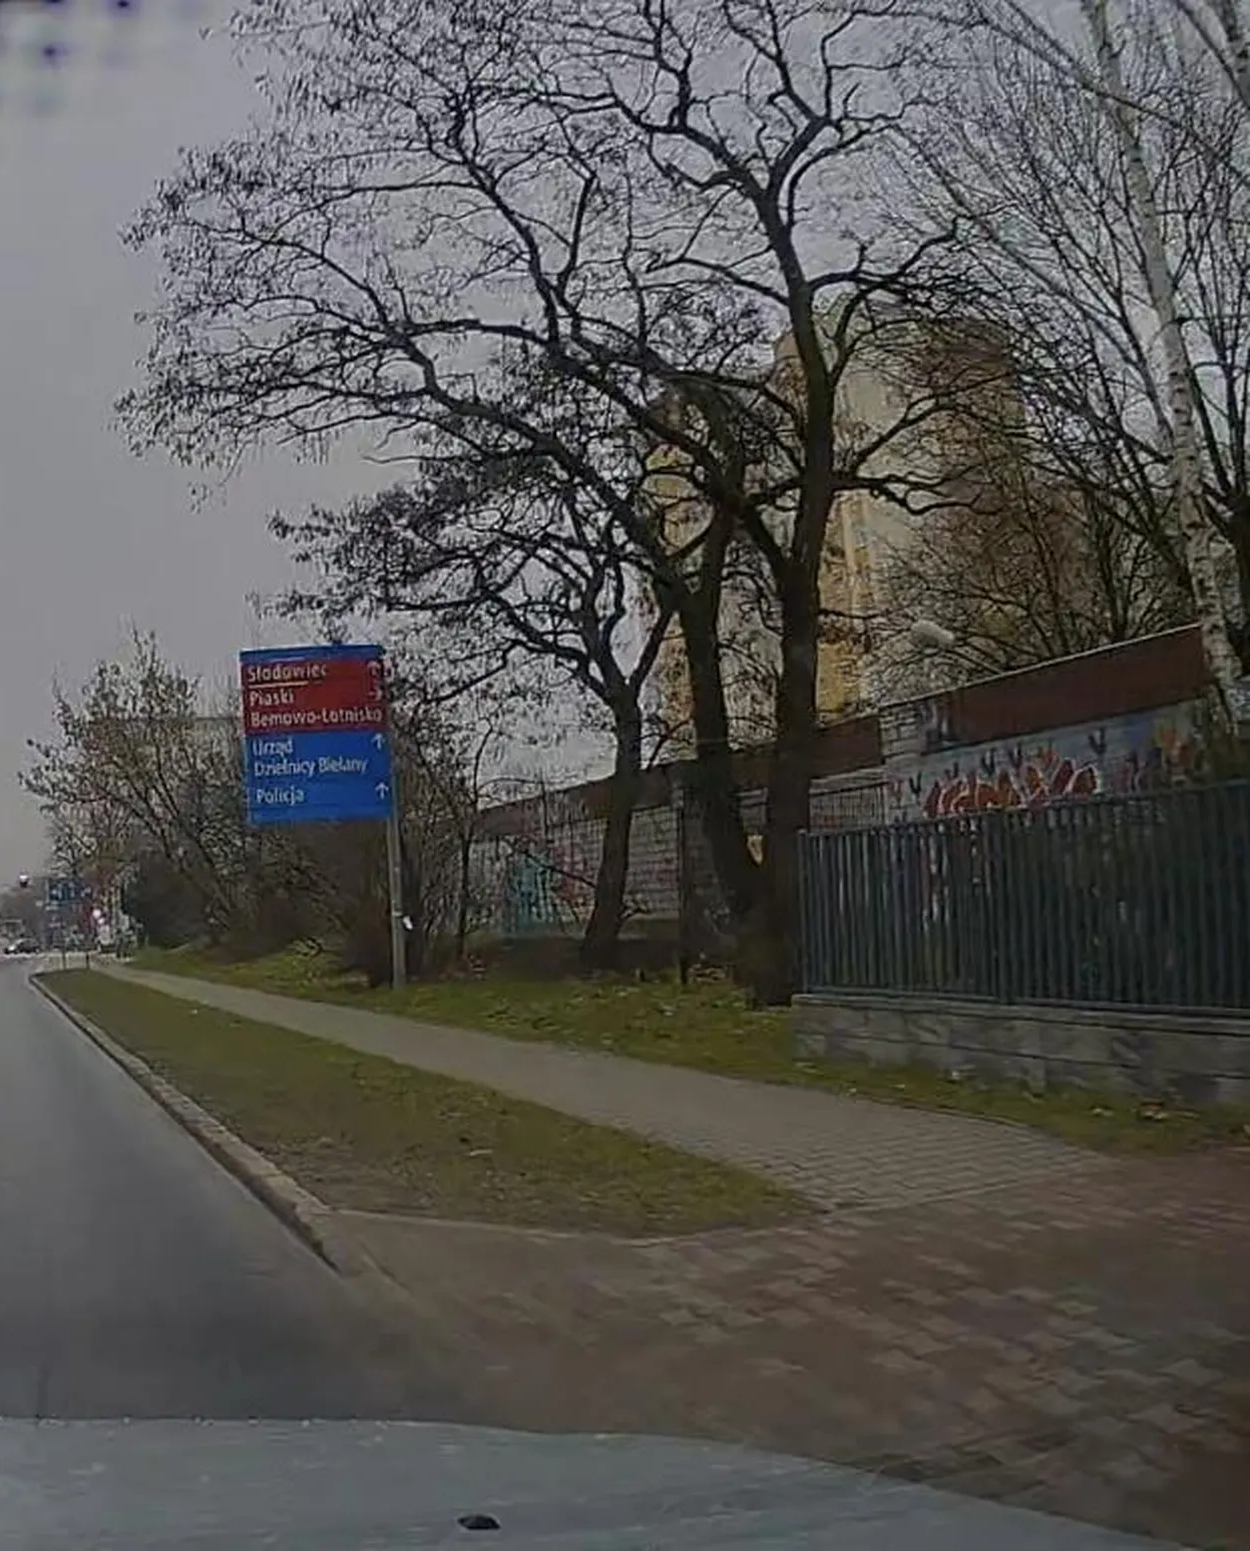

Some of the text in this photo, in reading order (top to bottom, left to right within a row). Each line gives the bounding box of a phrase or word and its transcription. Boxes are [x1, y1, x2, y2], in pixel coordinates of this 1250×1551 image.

[250, 688, 294, 706] Piaski
[252, 738, 294, 757] Urząd
[254, 756, 368, 778] Dzielnicy Bielany
[256, 785, 305, 806] Policja
